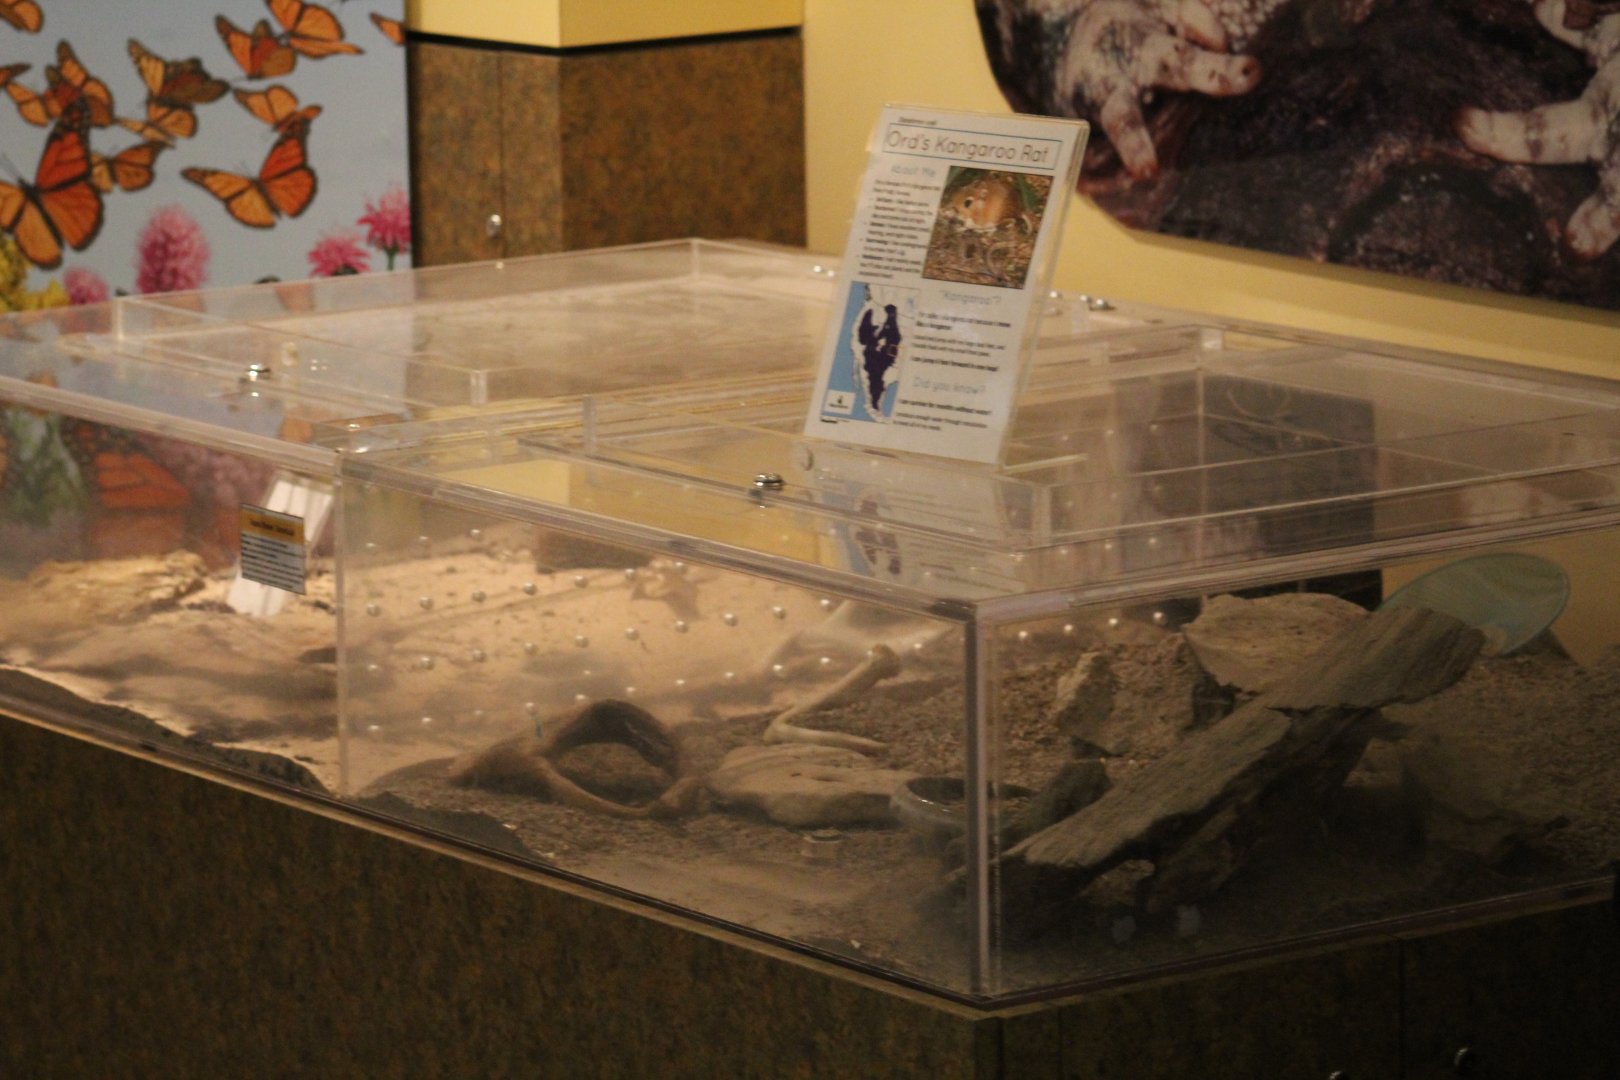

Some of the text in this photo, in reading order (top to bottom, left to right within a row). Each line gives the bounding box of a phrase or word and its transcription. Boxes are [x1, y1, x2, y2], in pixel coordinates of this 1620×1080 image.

[887, 130, 1049, 163] Ord's Kangaroo Rat
